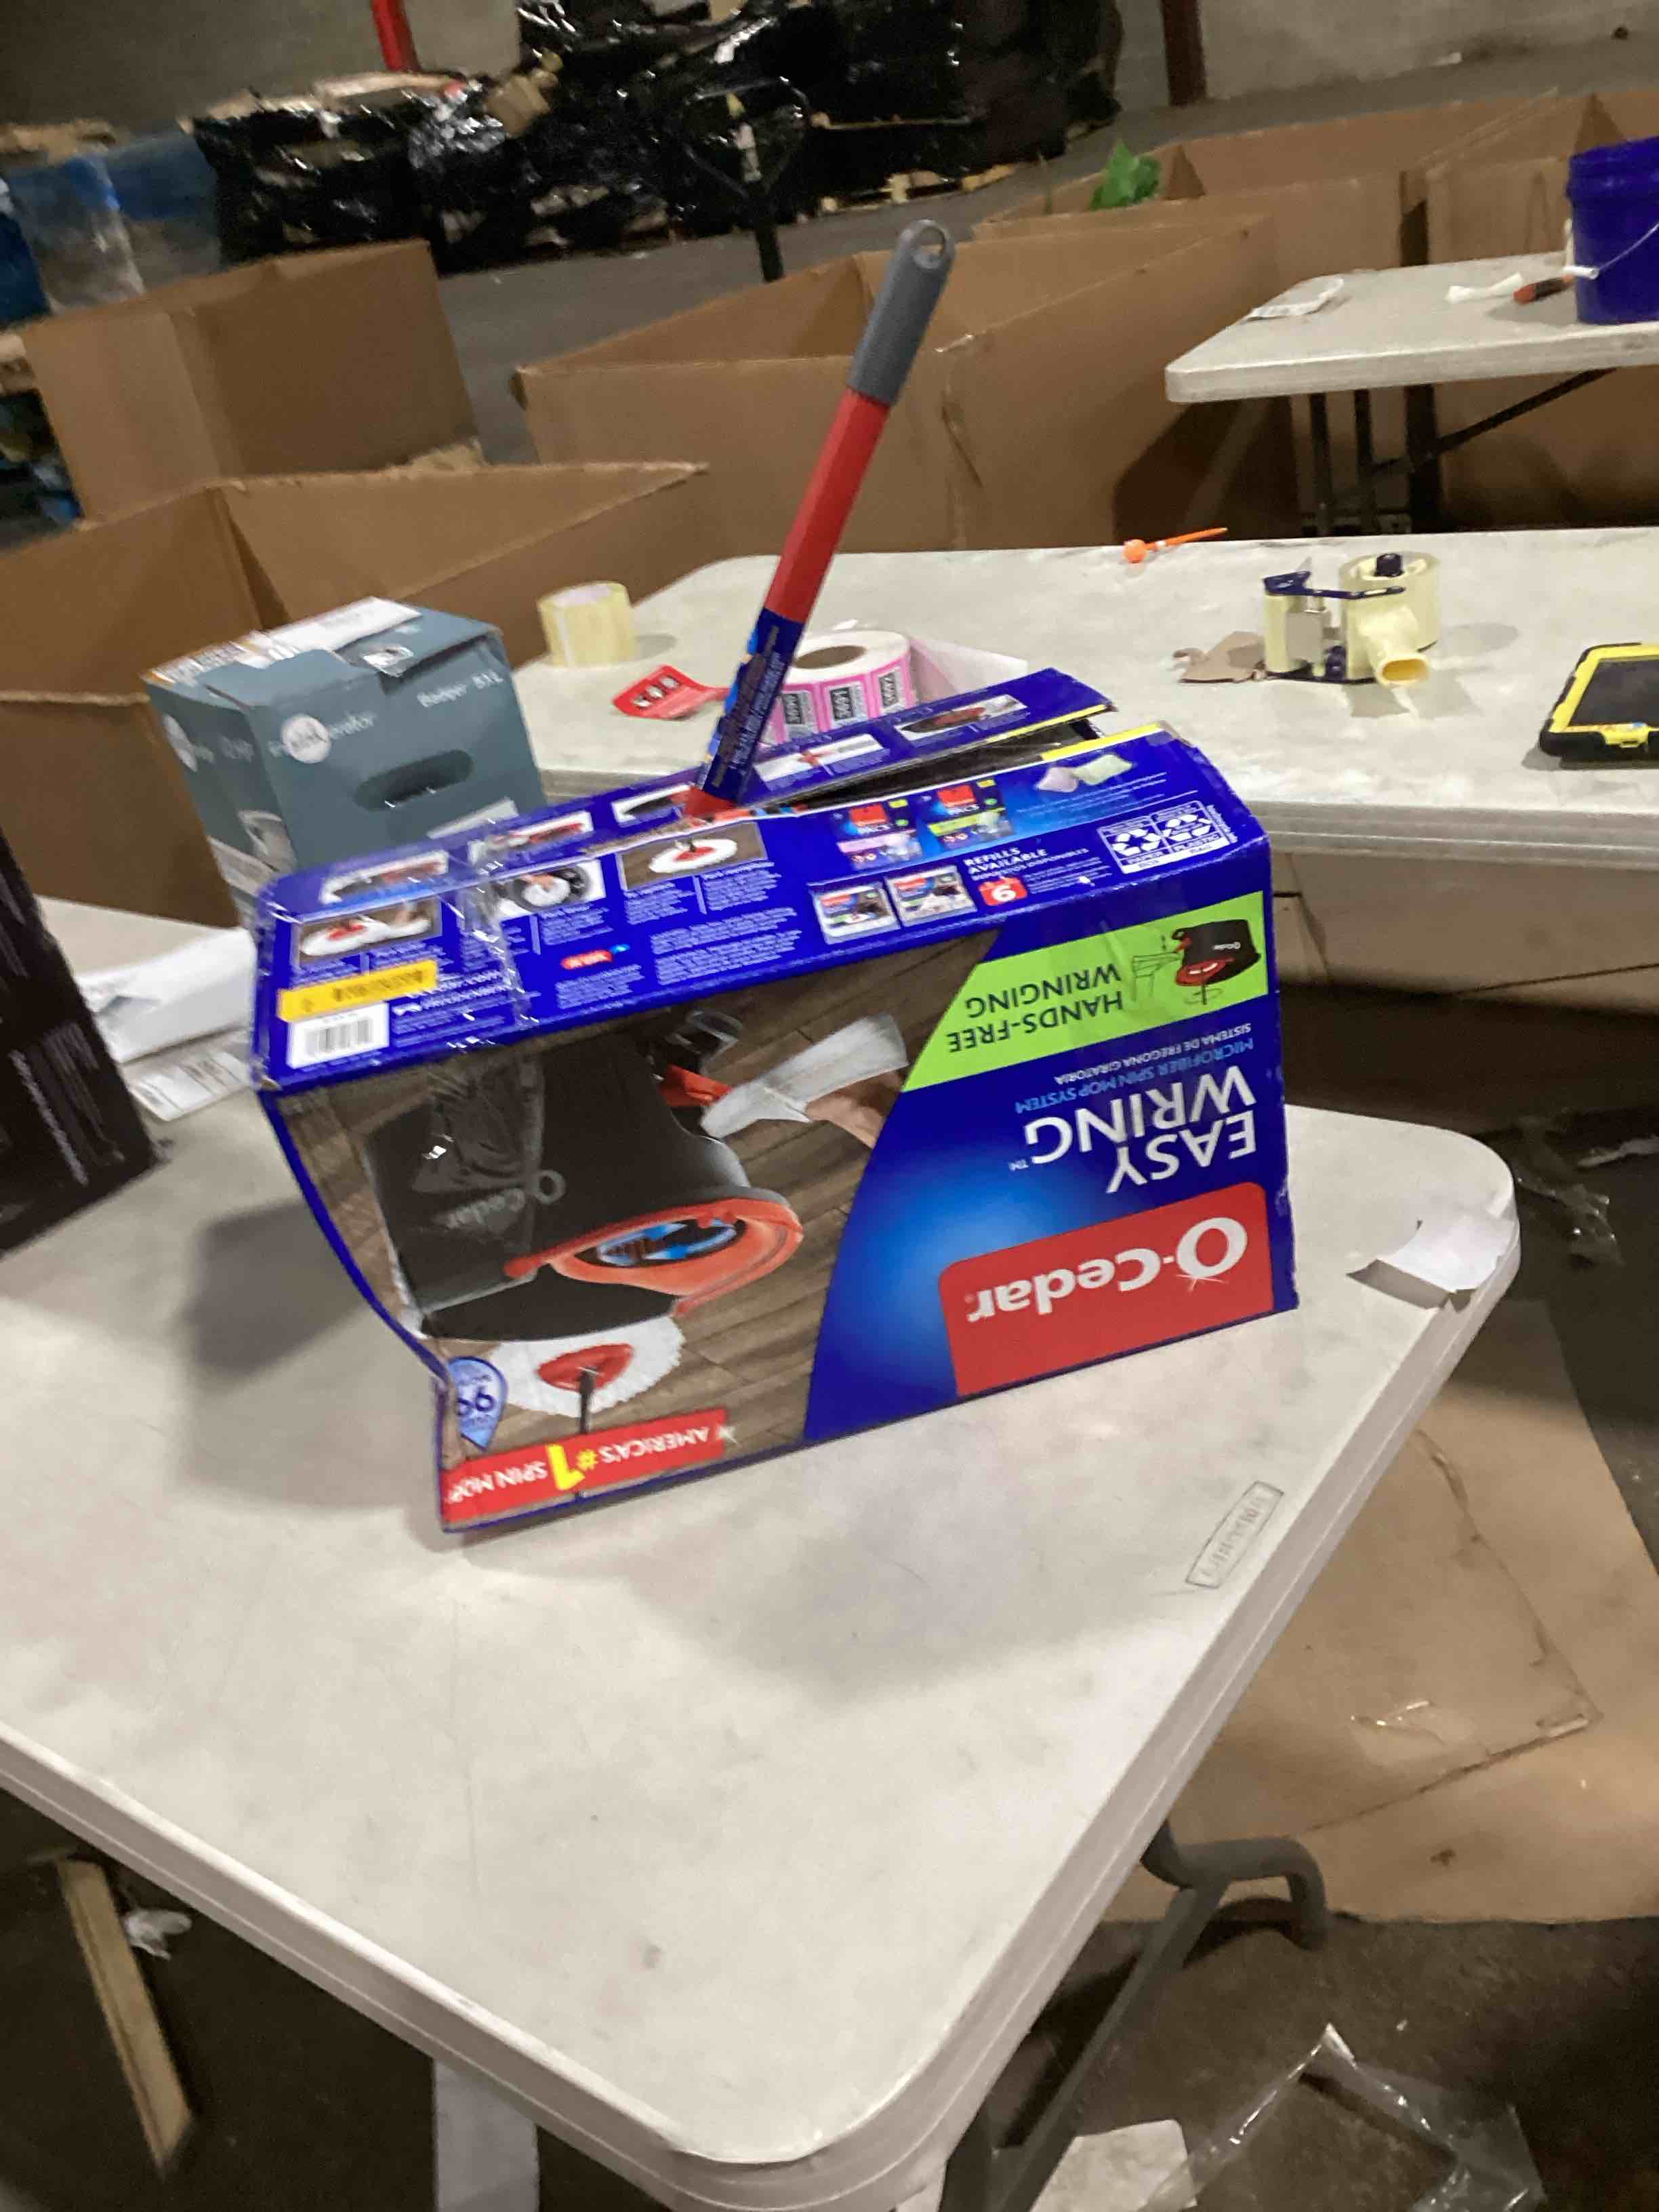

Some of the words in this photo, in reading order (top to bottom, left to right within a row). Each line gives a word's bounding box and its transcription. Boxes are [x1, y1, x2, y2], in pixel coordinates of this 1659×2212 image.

[962, 846, 1021, 867] REFILLS
[968, 848, 1049, 875] AVAILABLE
[964, 963, 1121, 1019] WRINGING
[945, 990, 1123, 1054] HANDS-FREE
[1201, 1022, 1252, 1046] SISTEMA
[1123, 1044, 1182, 1067] FREGONA
[1157, 1037, 1254, 1076] MICROFIBER
[1182, 1039, 1200, 1051] DE
[1077, 1076, 1117, 1098] MOP
[1118, 1065, 1155, 1086] SPIN
[1015, 1086, 1077, 1114] SYSTEM
[1023, 1065, 1256, 1165] WRING
[1106, 1110, 1256, 1193] EASY
[965, 1217, 1248, 1323] O-Cedar
[597, 1427, 710, 1465] AMERICA'S
[493, 1460, 548, 1488] SPIN
